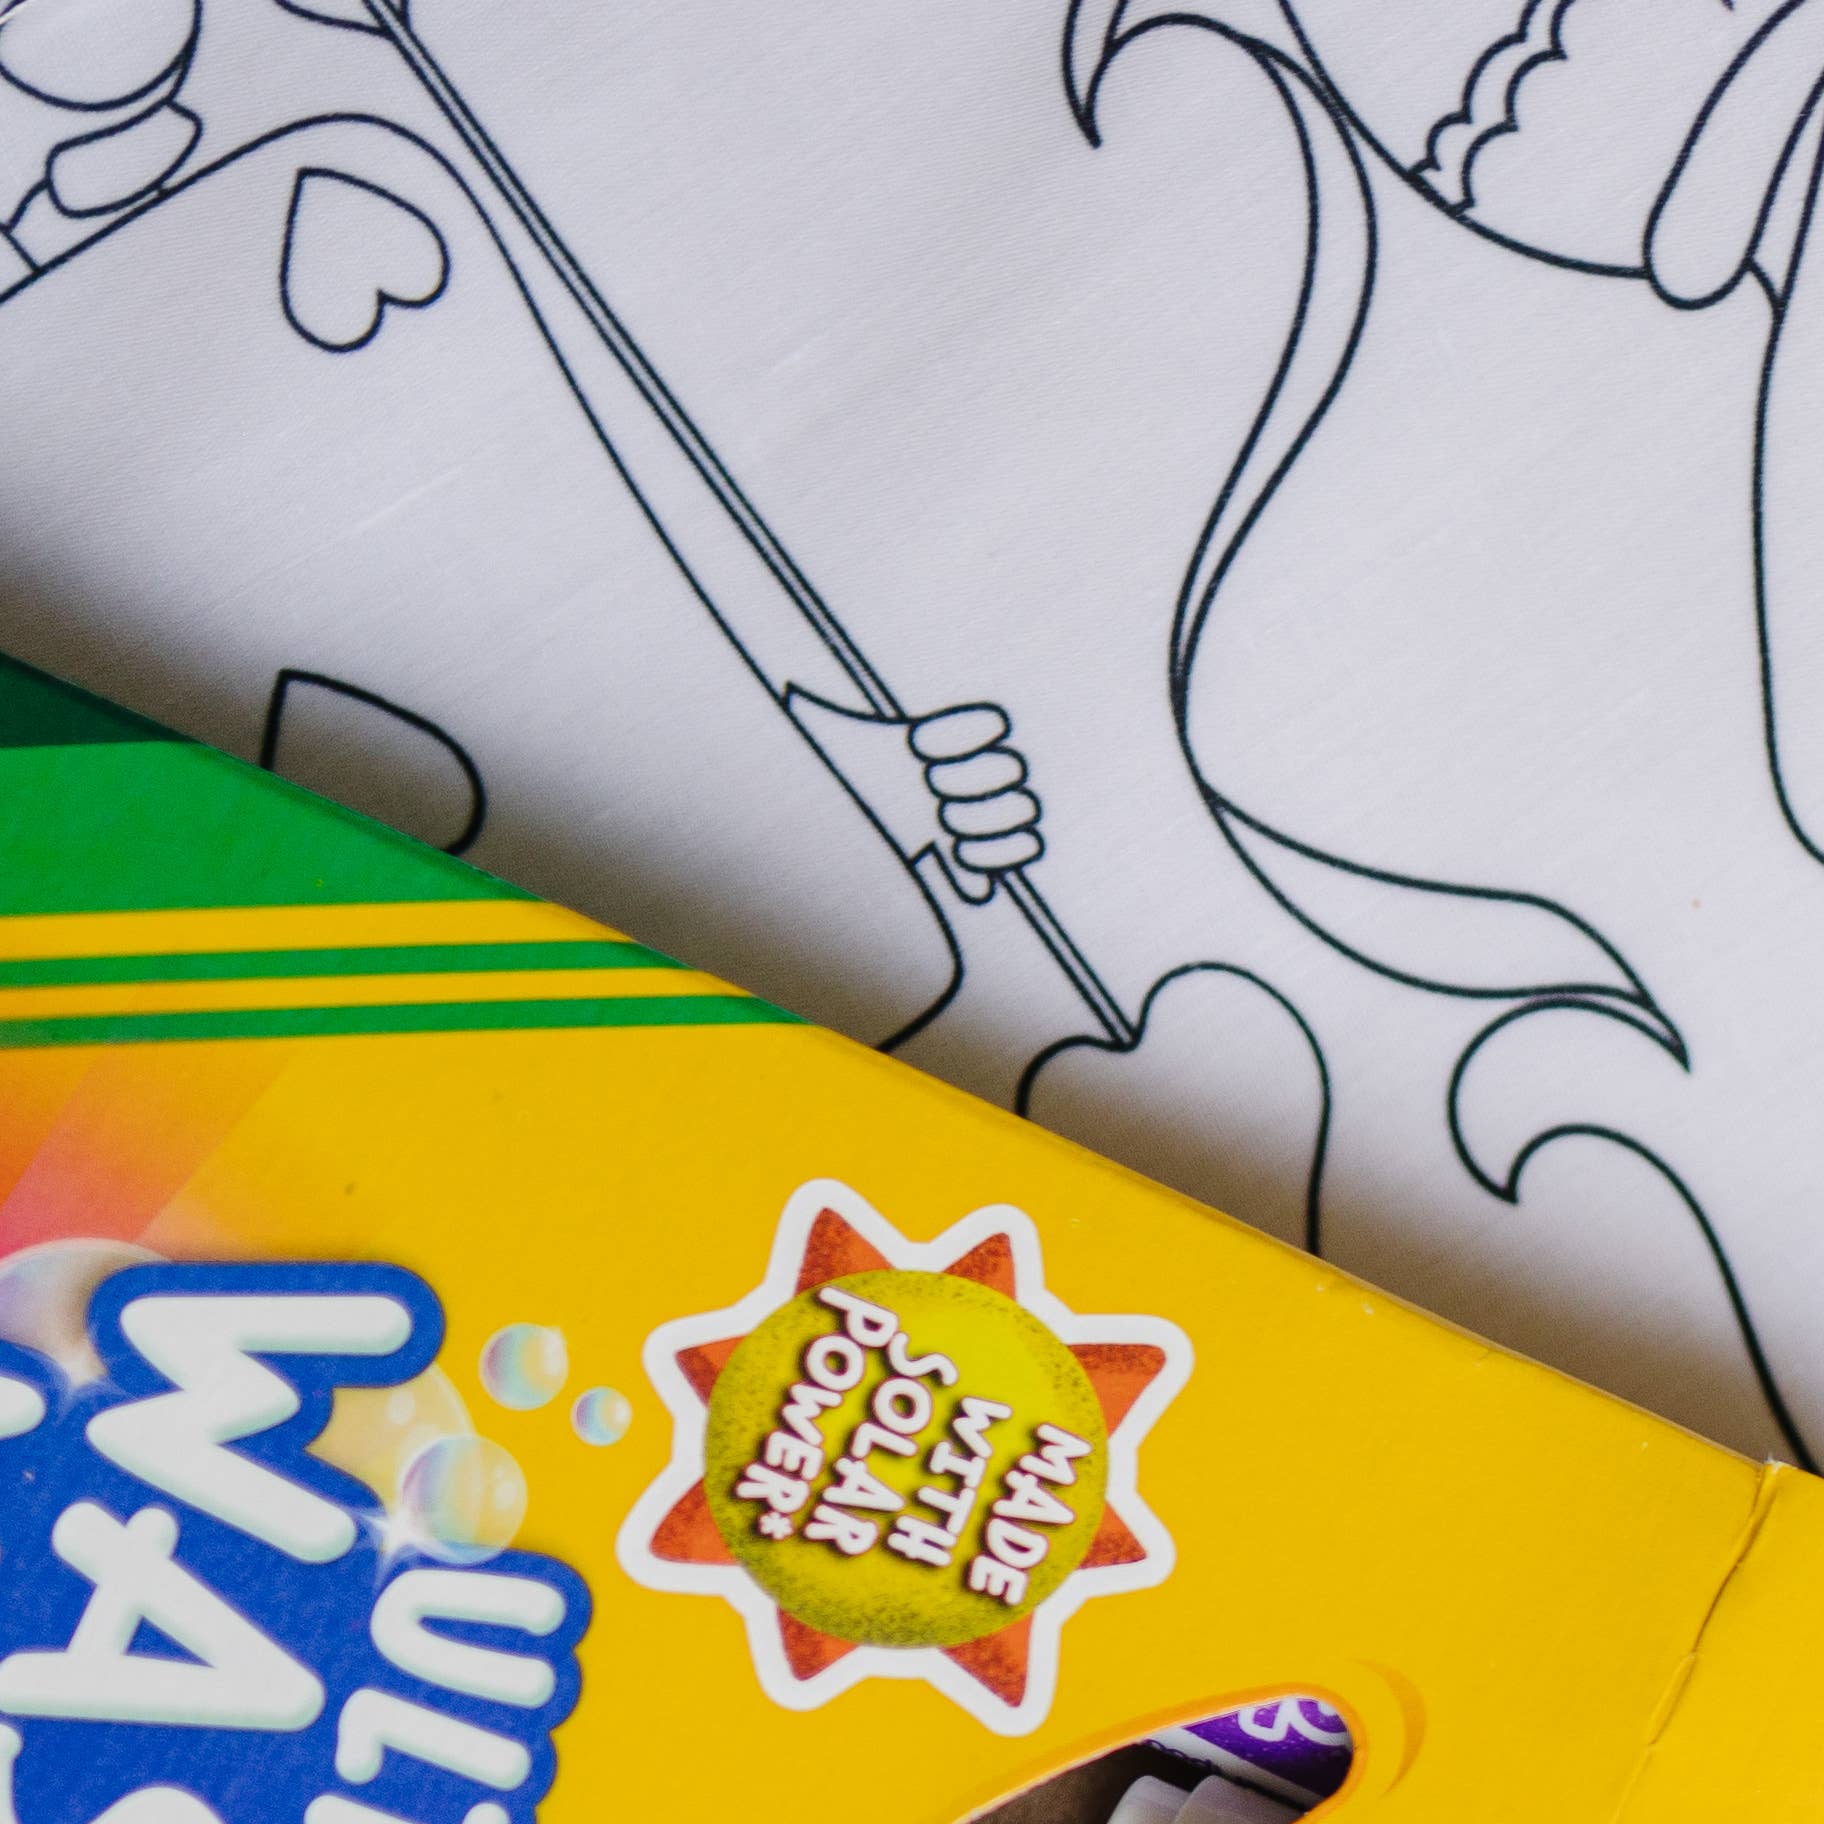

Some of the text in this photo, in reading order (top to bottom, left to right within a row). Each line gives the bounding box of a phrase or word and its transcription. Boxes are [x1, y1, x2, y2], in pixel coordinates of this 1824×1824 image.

[805, 1332, 958, 1557] SOLAR
[886, 1395, 1012, 1567] WITH
[967, 1423, 1093, 1606] MADE
